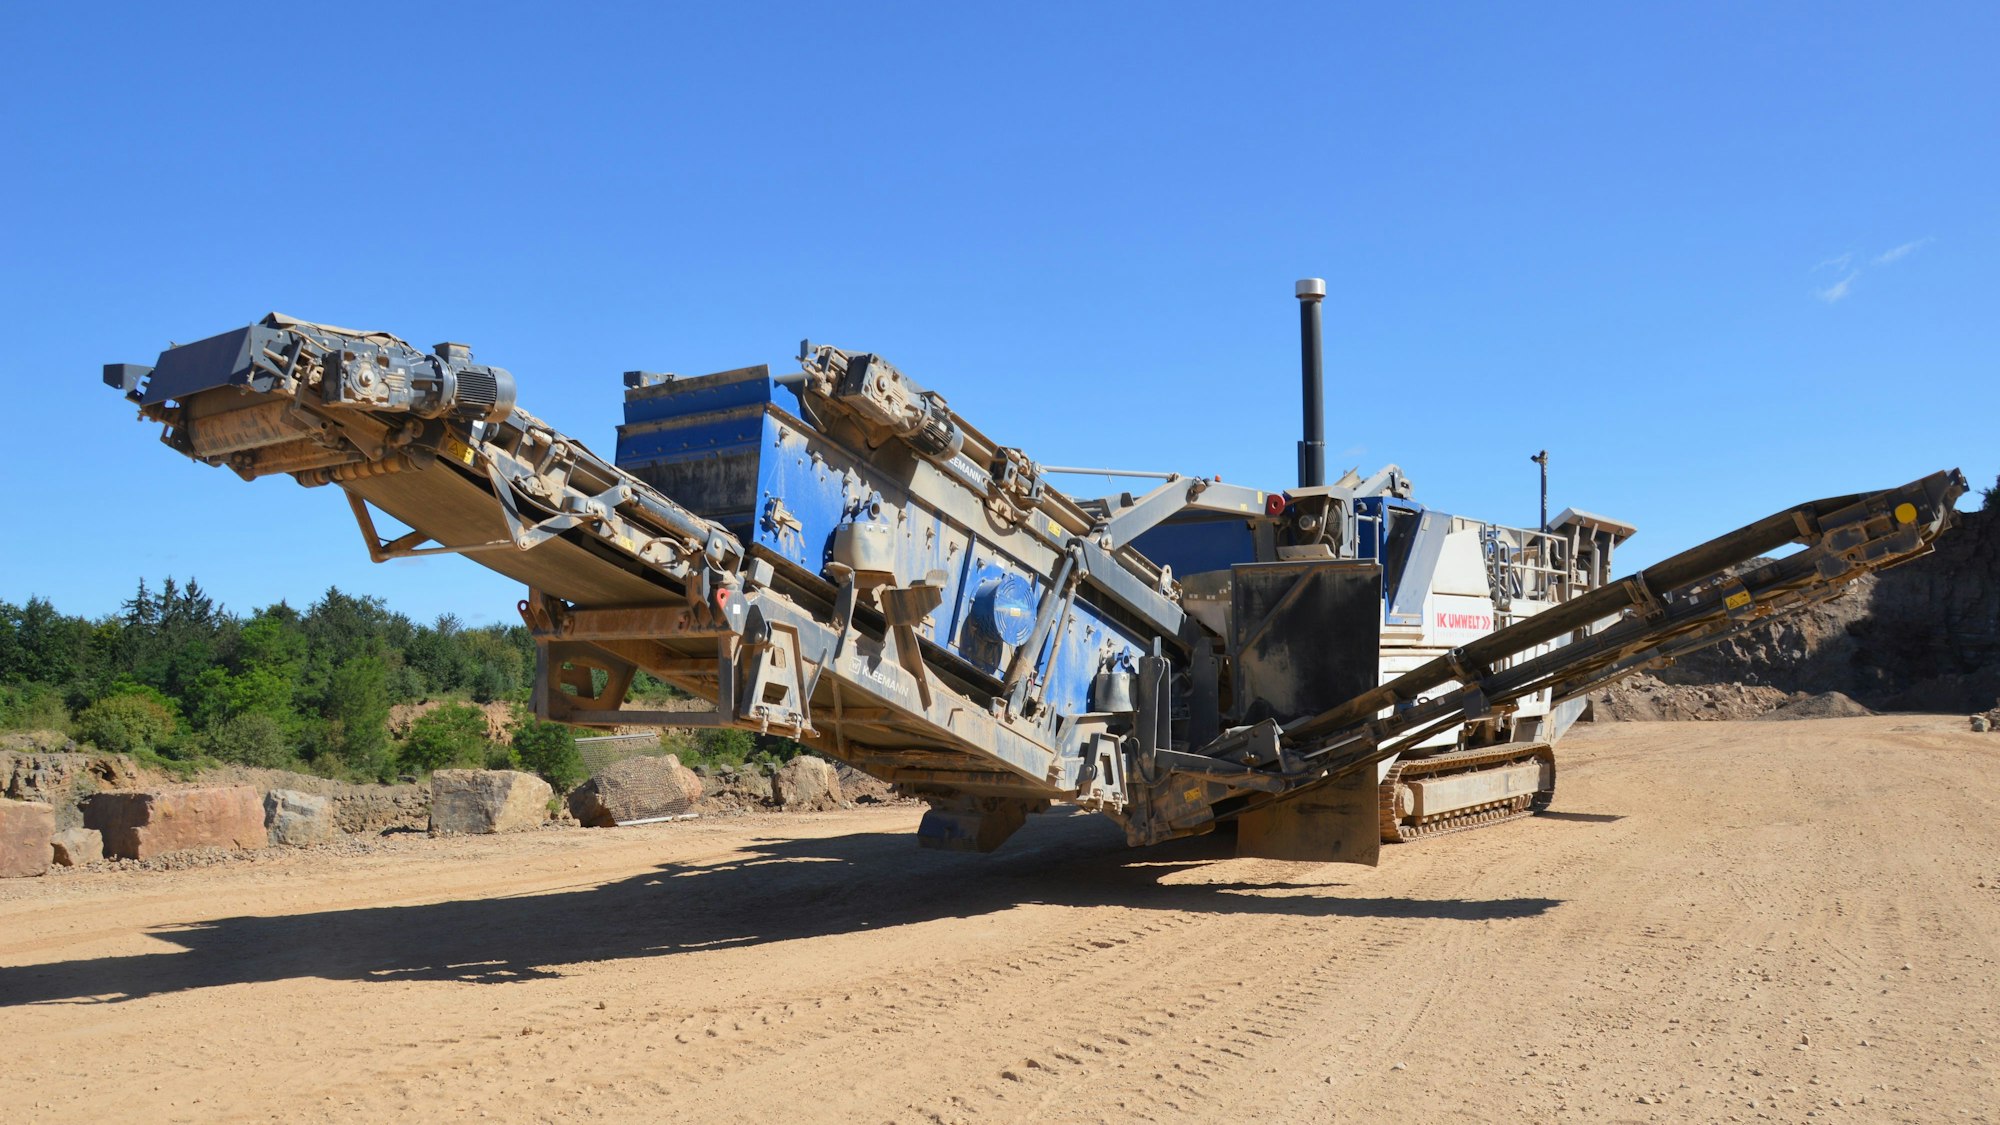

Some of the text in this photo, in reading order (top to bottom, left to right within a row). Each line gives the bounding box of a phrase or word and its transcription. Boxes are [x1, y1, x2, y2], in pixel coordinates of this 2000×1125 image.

[949, 456, 981, 483] EEMANN
[1437, 613, 1479, 629] IK UMWELT
